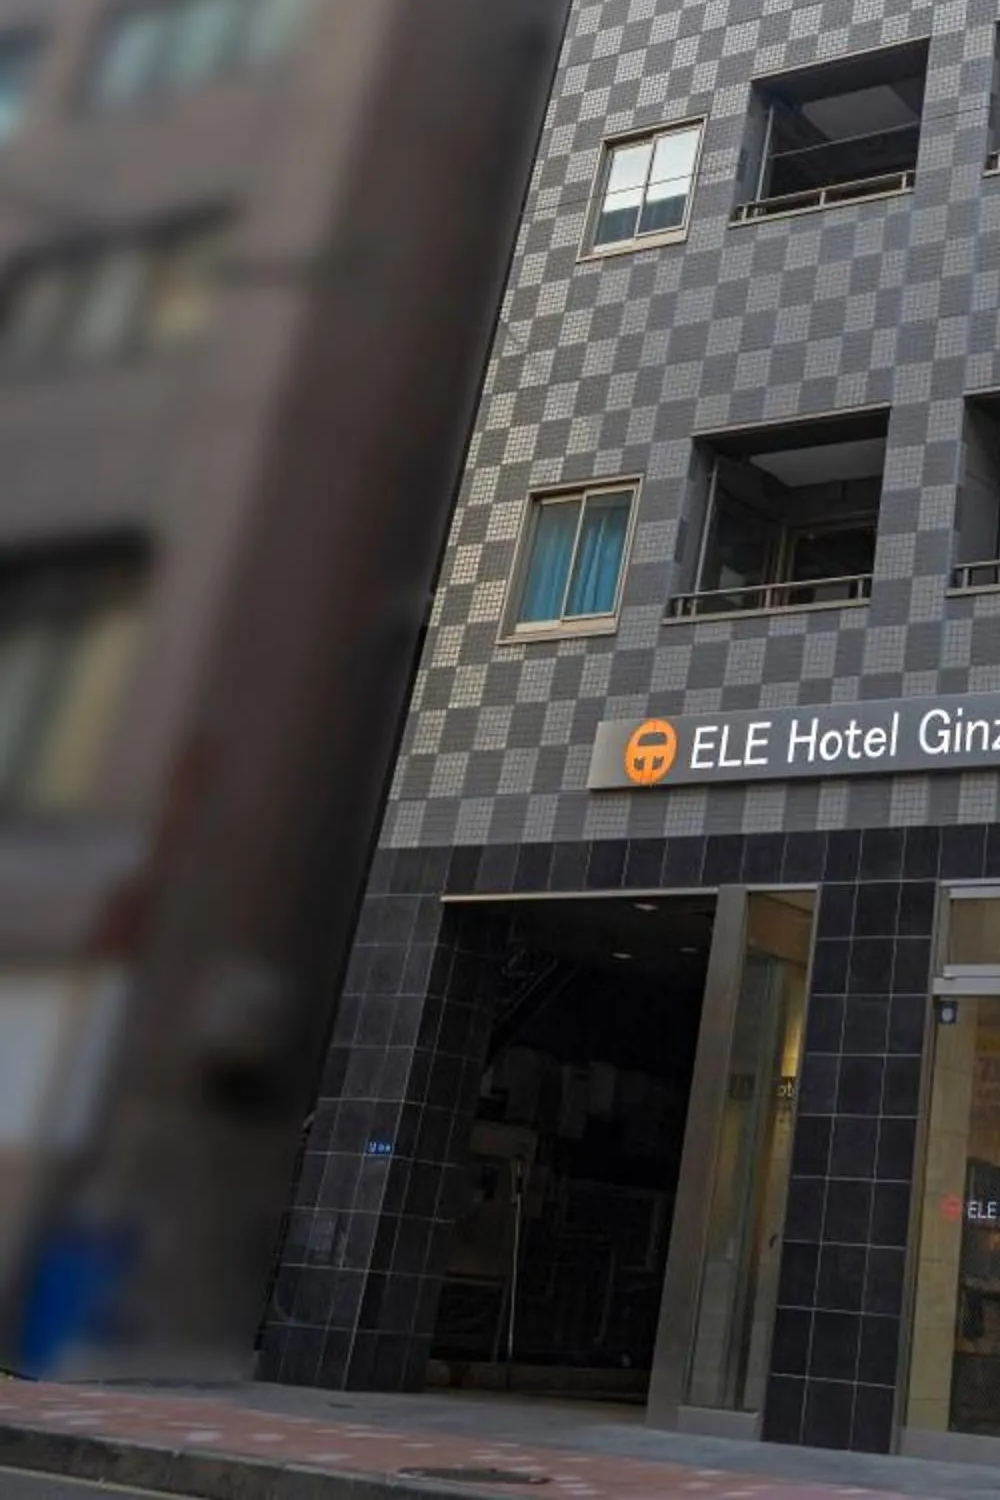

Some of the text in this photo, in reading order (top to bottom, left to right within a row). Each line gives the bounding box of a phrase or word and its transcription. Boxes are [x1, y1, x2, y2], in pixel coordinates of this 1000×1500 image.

[689, 721, 773, 770] ELE
[786, 712, 900, 762] Hotel
[967, 1201, 997, 1219] ELE
